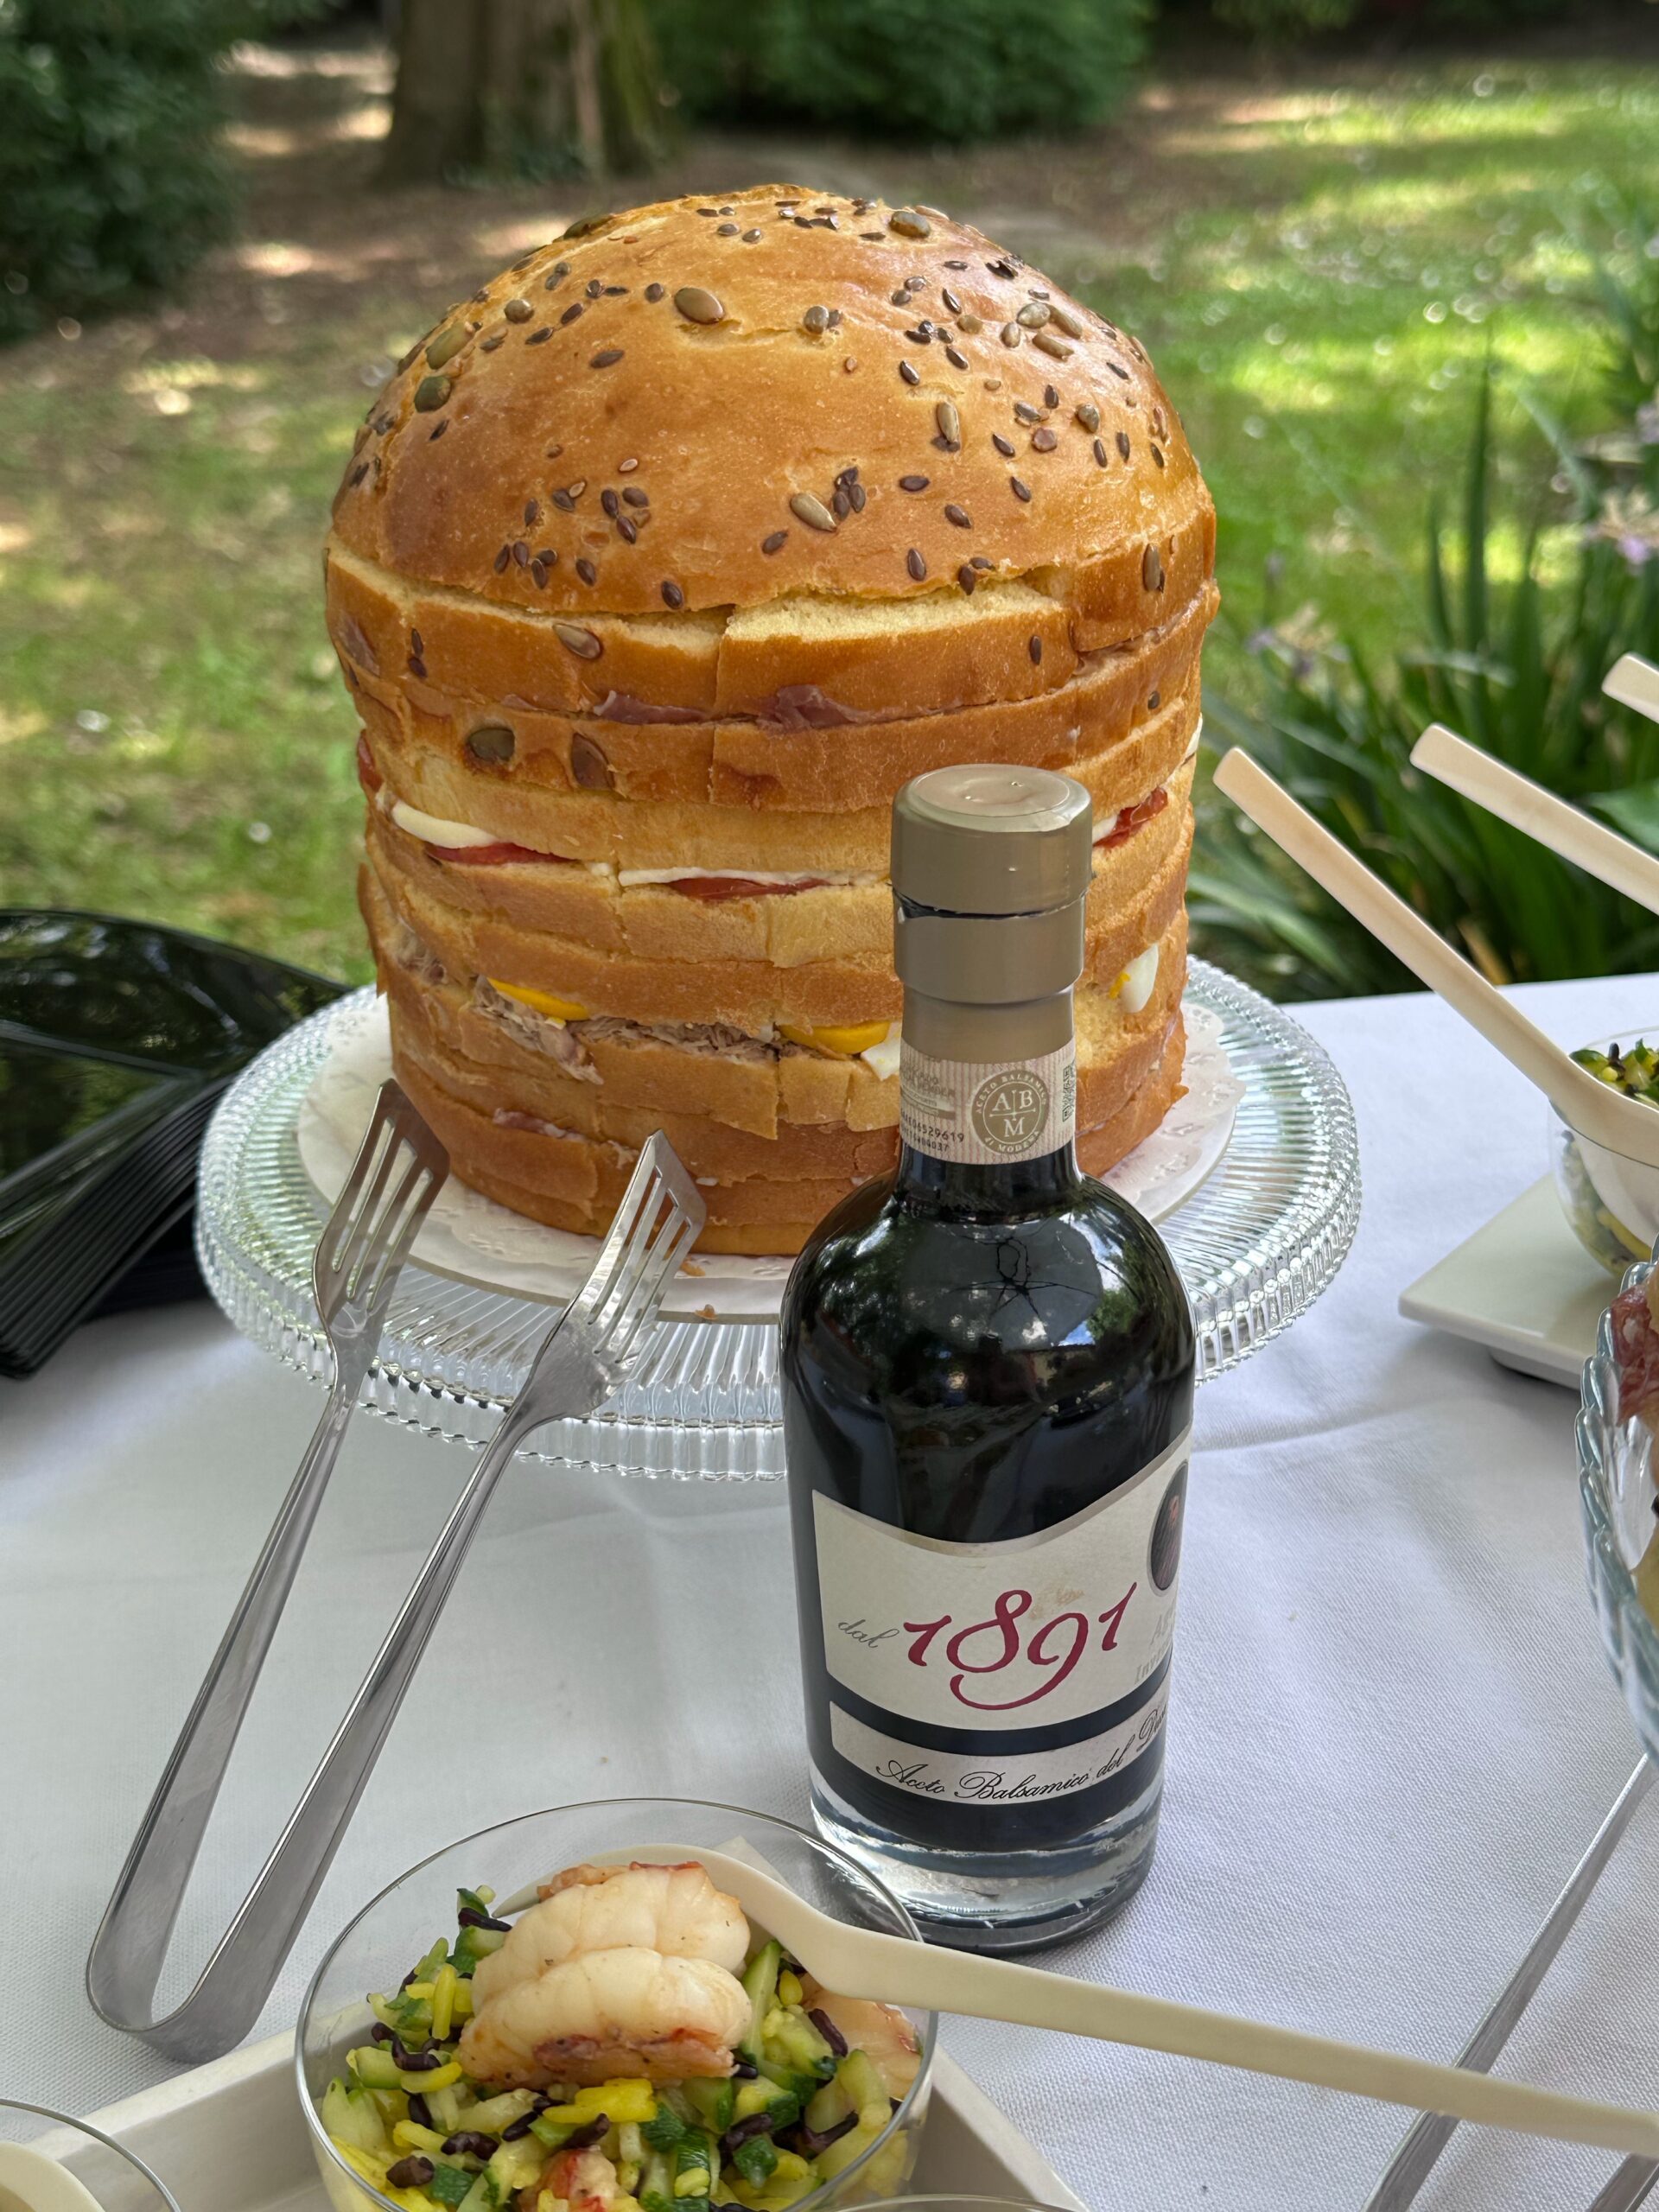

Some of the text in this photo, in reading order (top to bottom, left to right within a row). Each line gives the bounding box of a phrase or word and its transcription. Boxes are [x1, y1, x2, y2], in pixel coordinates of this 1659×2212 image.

[992, 1090, 1033, 1111] A B
[1003, 1116, 1026, 1138] M
[837, 1618, 899, 1649] dal
[903, 1582, 1137, 1710] 1891
[875, 1759, 945, 1794] Aceto
[953, 1770, 1088, 1800] Balsamico
[1096, 1733, 1135, 1779] del
